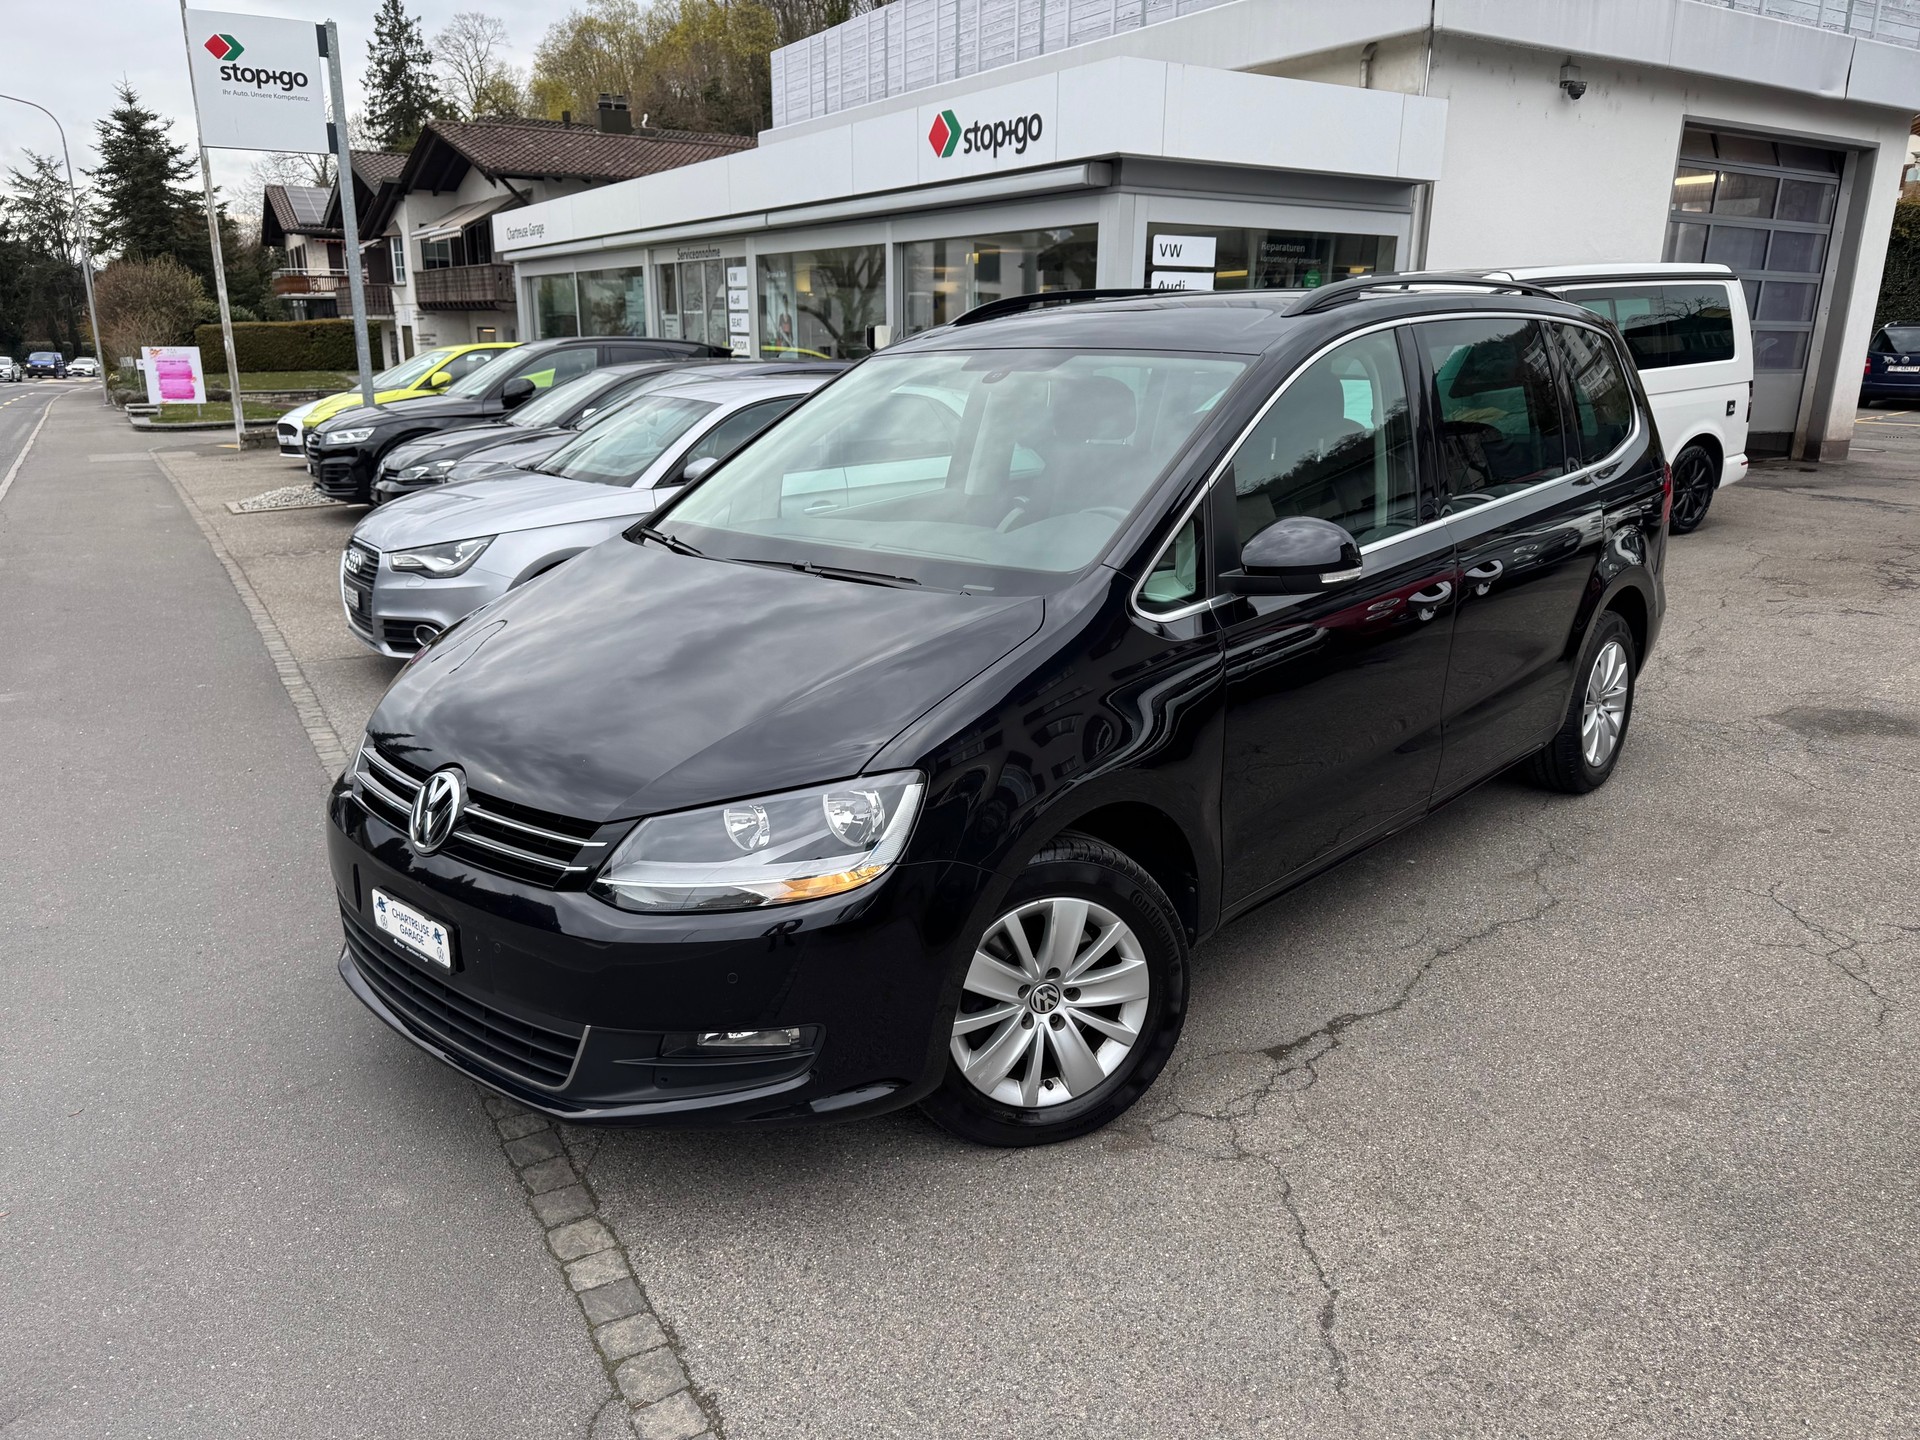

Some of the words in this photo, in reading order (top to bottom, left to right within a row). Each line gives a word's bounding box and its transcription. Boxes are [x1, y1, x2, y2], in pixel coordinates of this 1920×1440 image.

[220, 63, 308, 91] stop+go
[250, 91, 273, 99] Unsere
[273, 93, 310, 102] Kompetenz.
[963, 113, 1043, 158] stop+go
[677, 243, 720, 260] Serviceannahme
[1159, 243, 1183, 258] VW
[1260, 241, 1305, 253] Reparaturen
[1158, 280, 1185, 289] Audi
[731, 317, 742, 327] SEAT
[391, 908, 430, 937] CHARTREUSE
[399, 924, 425, 946] GARAGE
